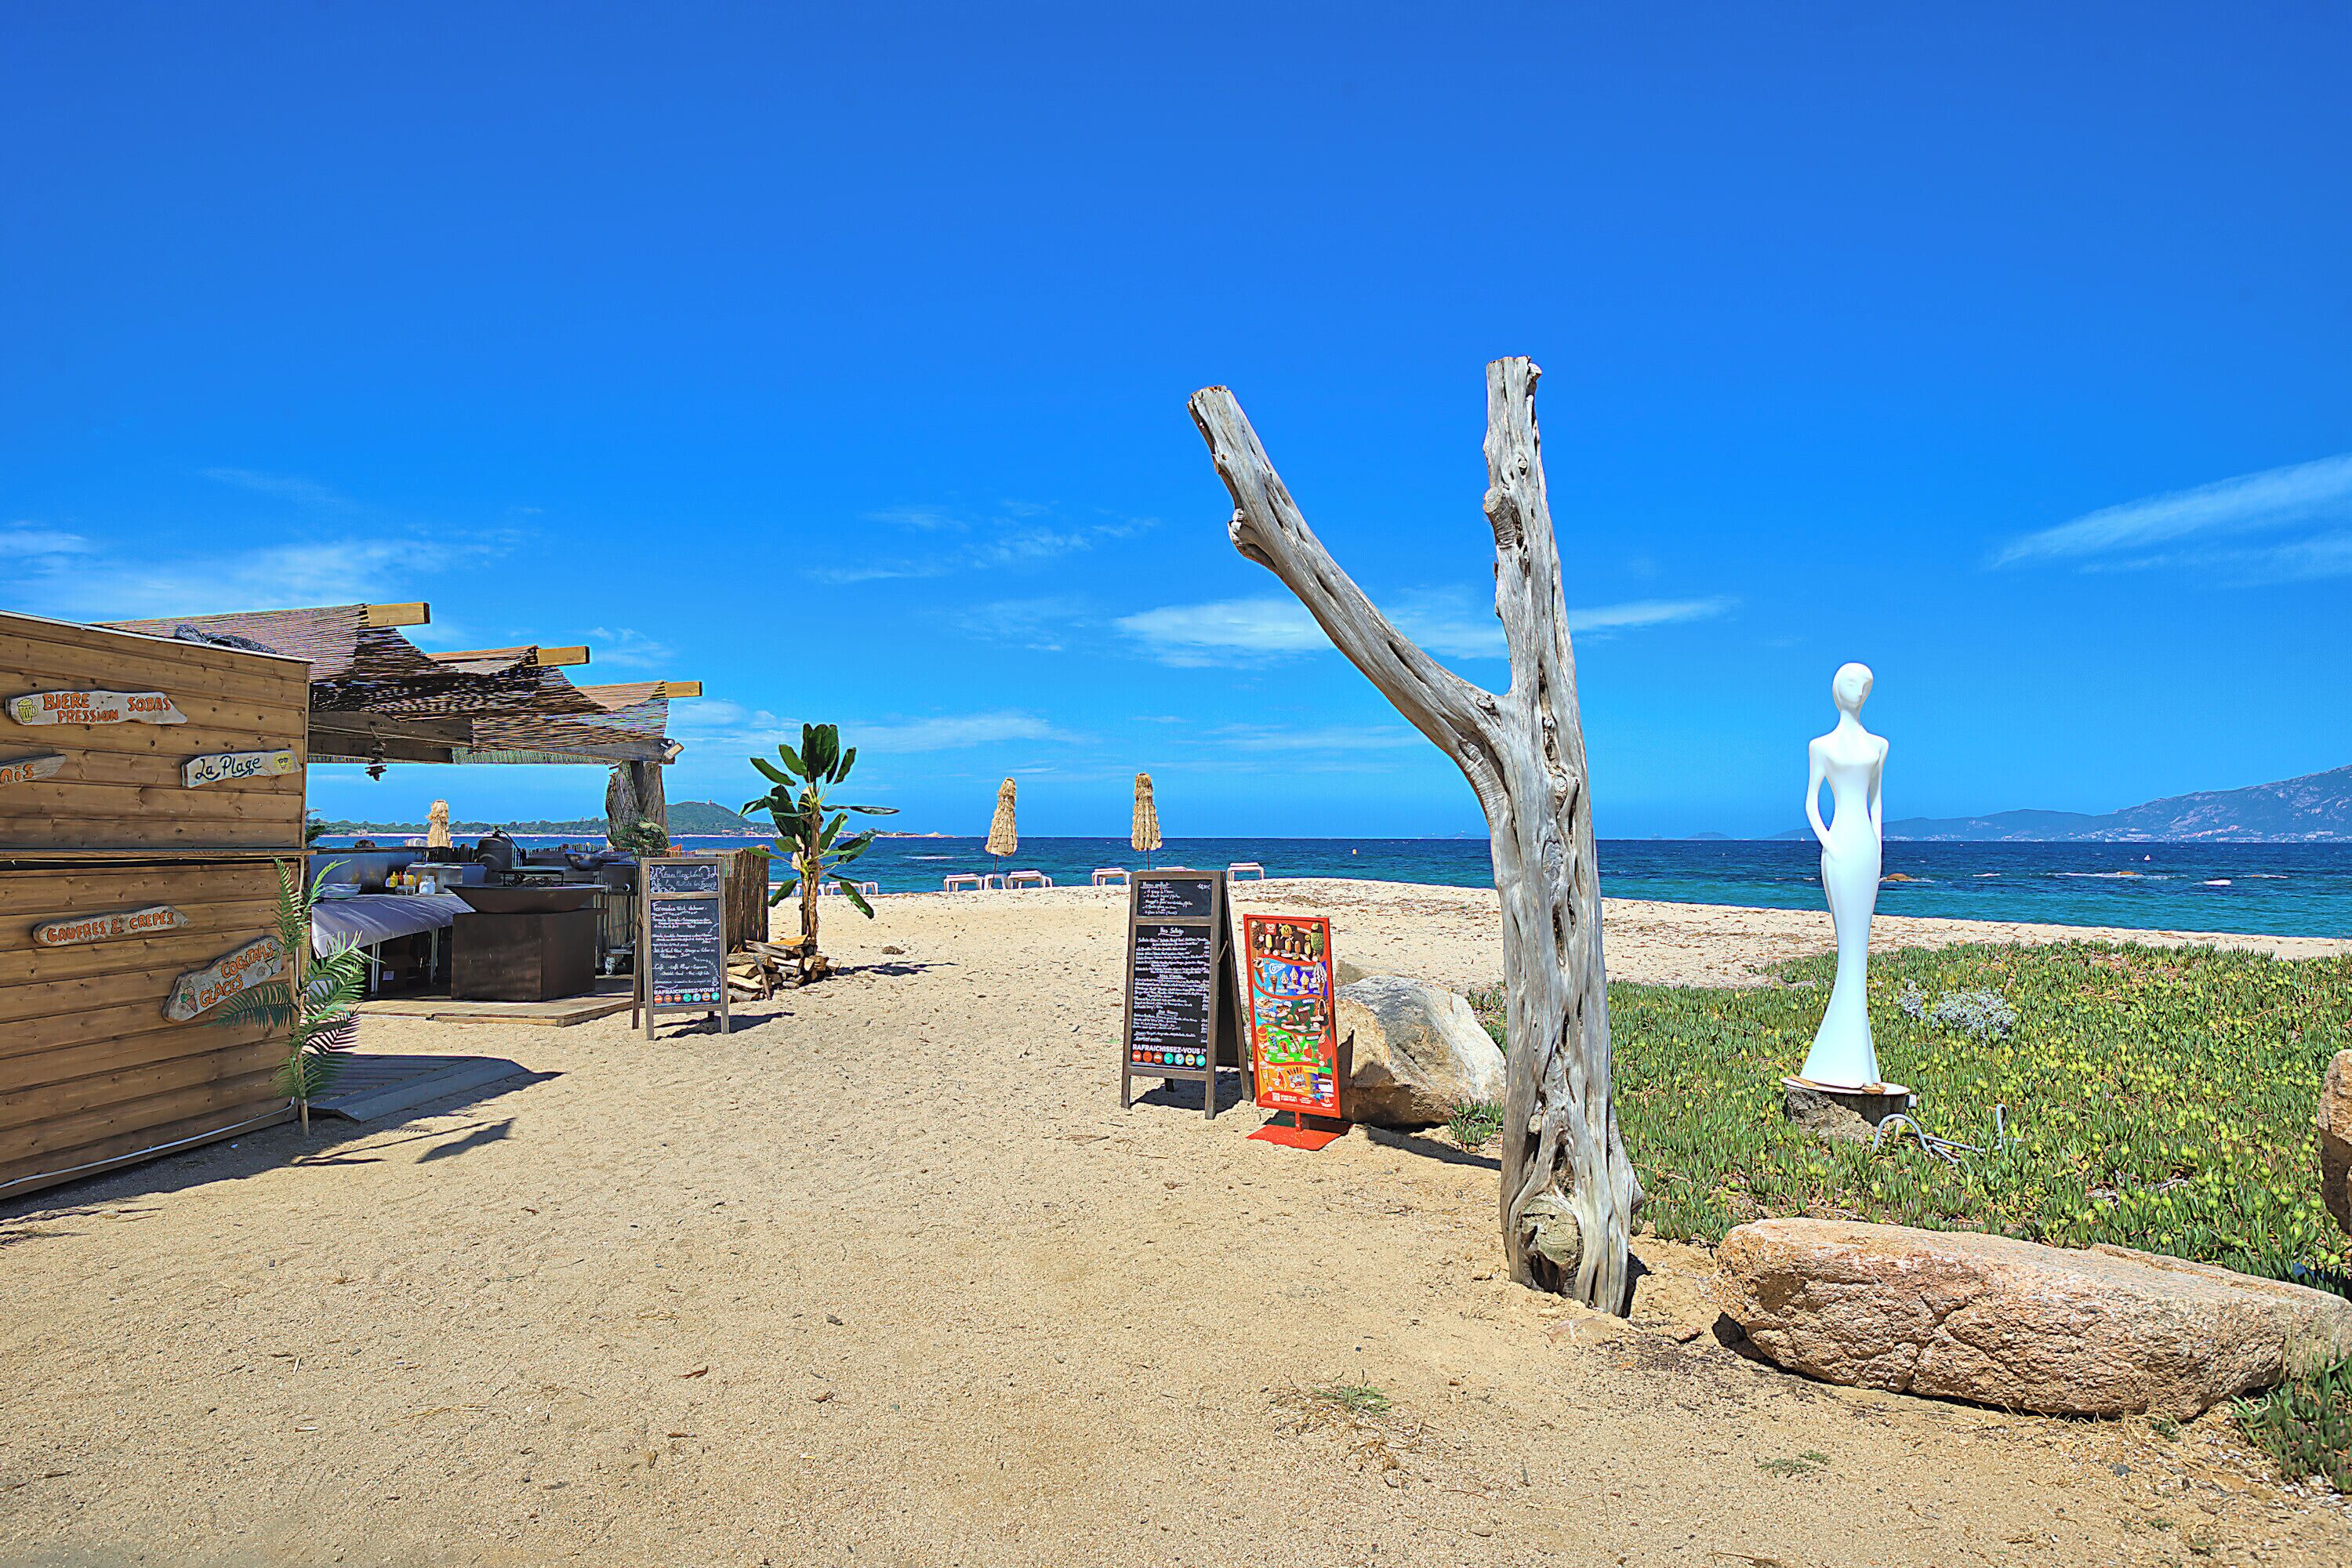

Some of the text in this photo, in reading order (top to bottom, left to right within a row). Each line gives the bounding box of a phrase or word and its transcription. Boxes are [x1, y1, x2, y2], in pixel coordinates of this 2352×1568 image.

[43, 693, 90, 710] BIERE
[127, 695, 171, 712] SODAS
[195, 755, 262, 780] La Plage
[47, 921, 106, 942] GAUFRES
[111, 919, 122, 934] &
[221, 942, 274, 978] COCKTAILS
[200, 974, 244, 1007] GLACES
[1133, 1044, 1200, 1054] RAFRAICHISSEZ-VOUS
